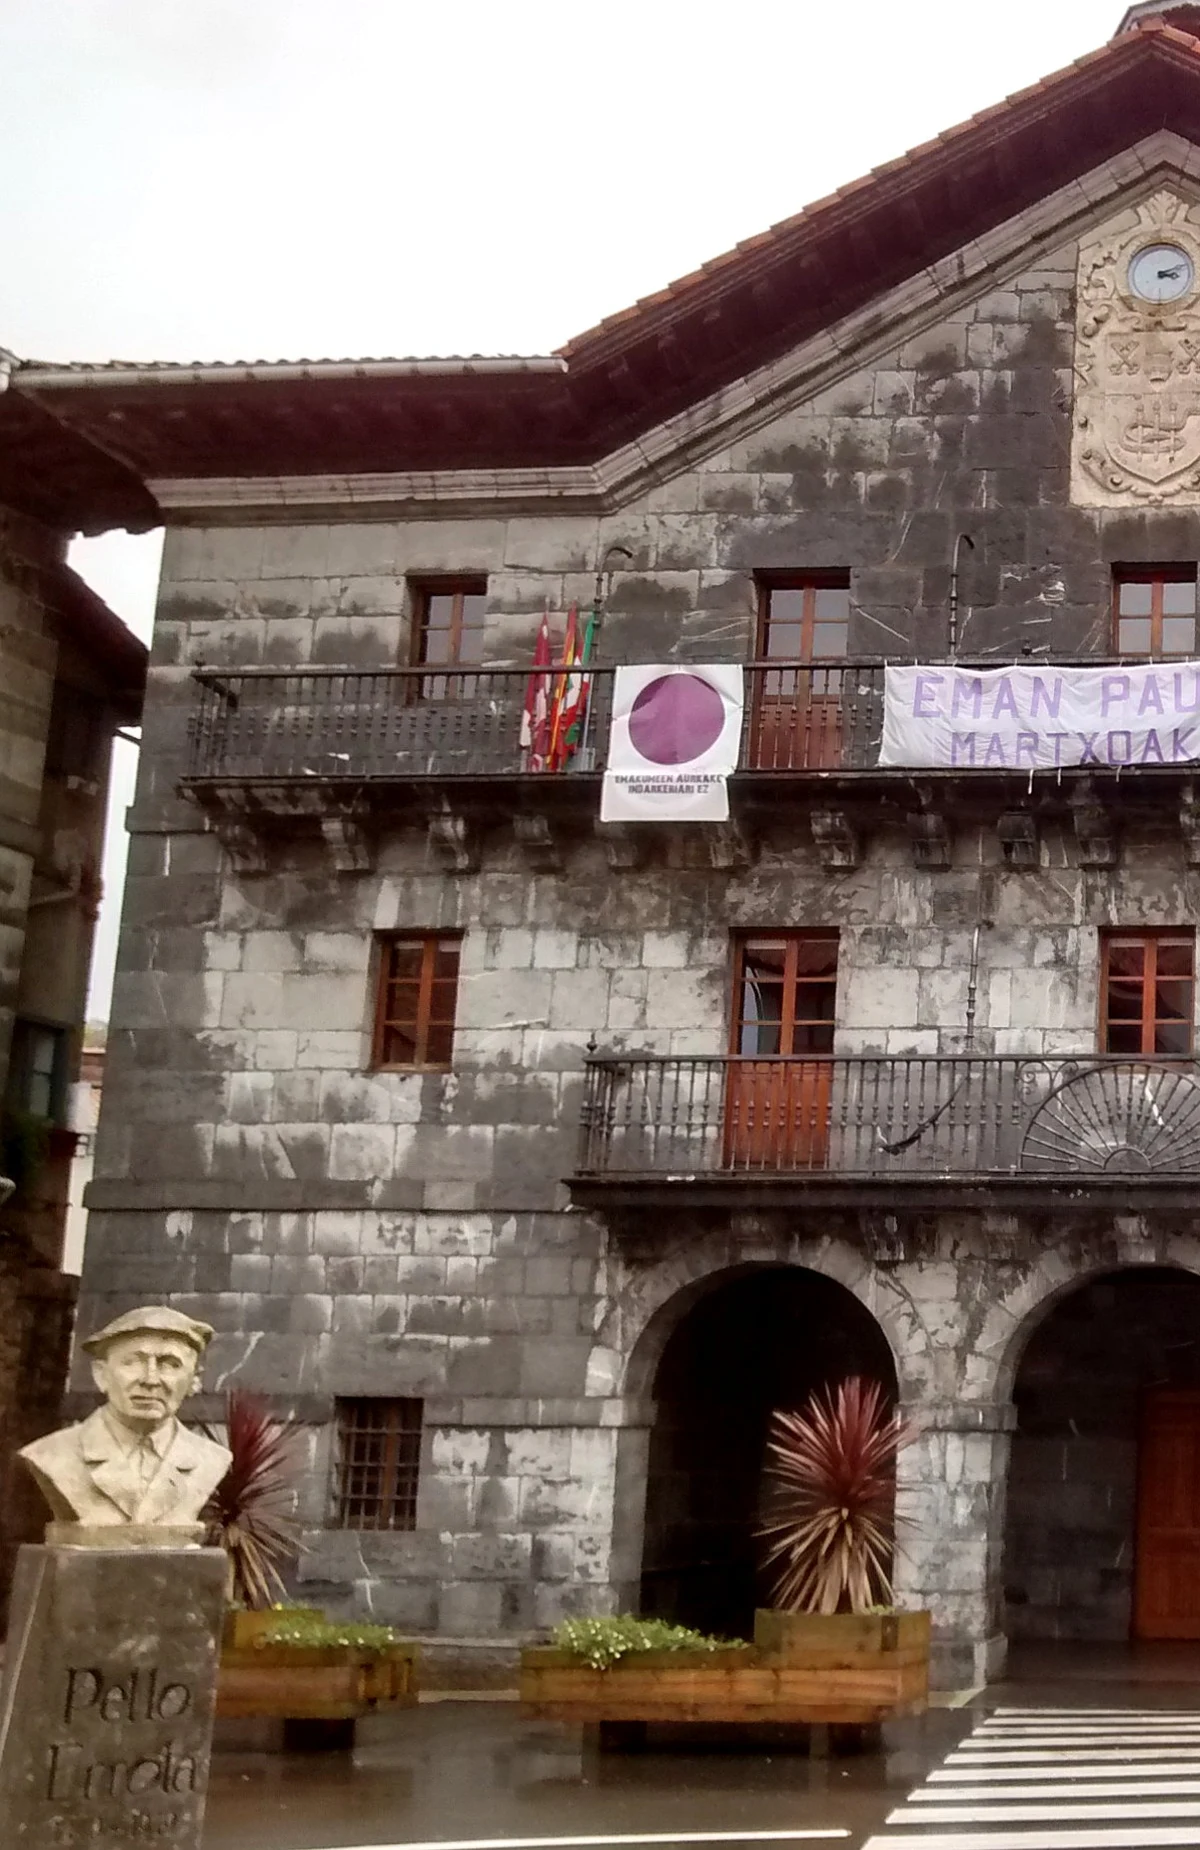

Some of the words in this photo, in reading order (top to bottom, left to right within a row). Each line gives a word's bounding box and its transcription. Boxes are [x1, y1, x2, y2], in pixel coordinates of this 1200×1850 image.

[912, 674, 1063, 719] EMAN
[949, 727, 1198, 767] MARTXOAK
[614, 774, 674, 784] EMAKUMEEN
[628, 784, 695, 794] INDARKERIARI
[697, 784, 710, 794] EZ
[62, 1666, 192, 1724] Pello
